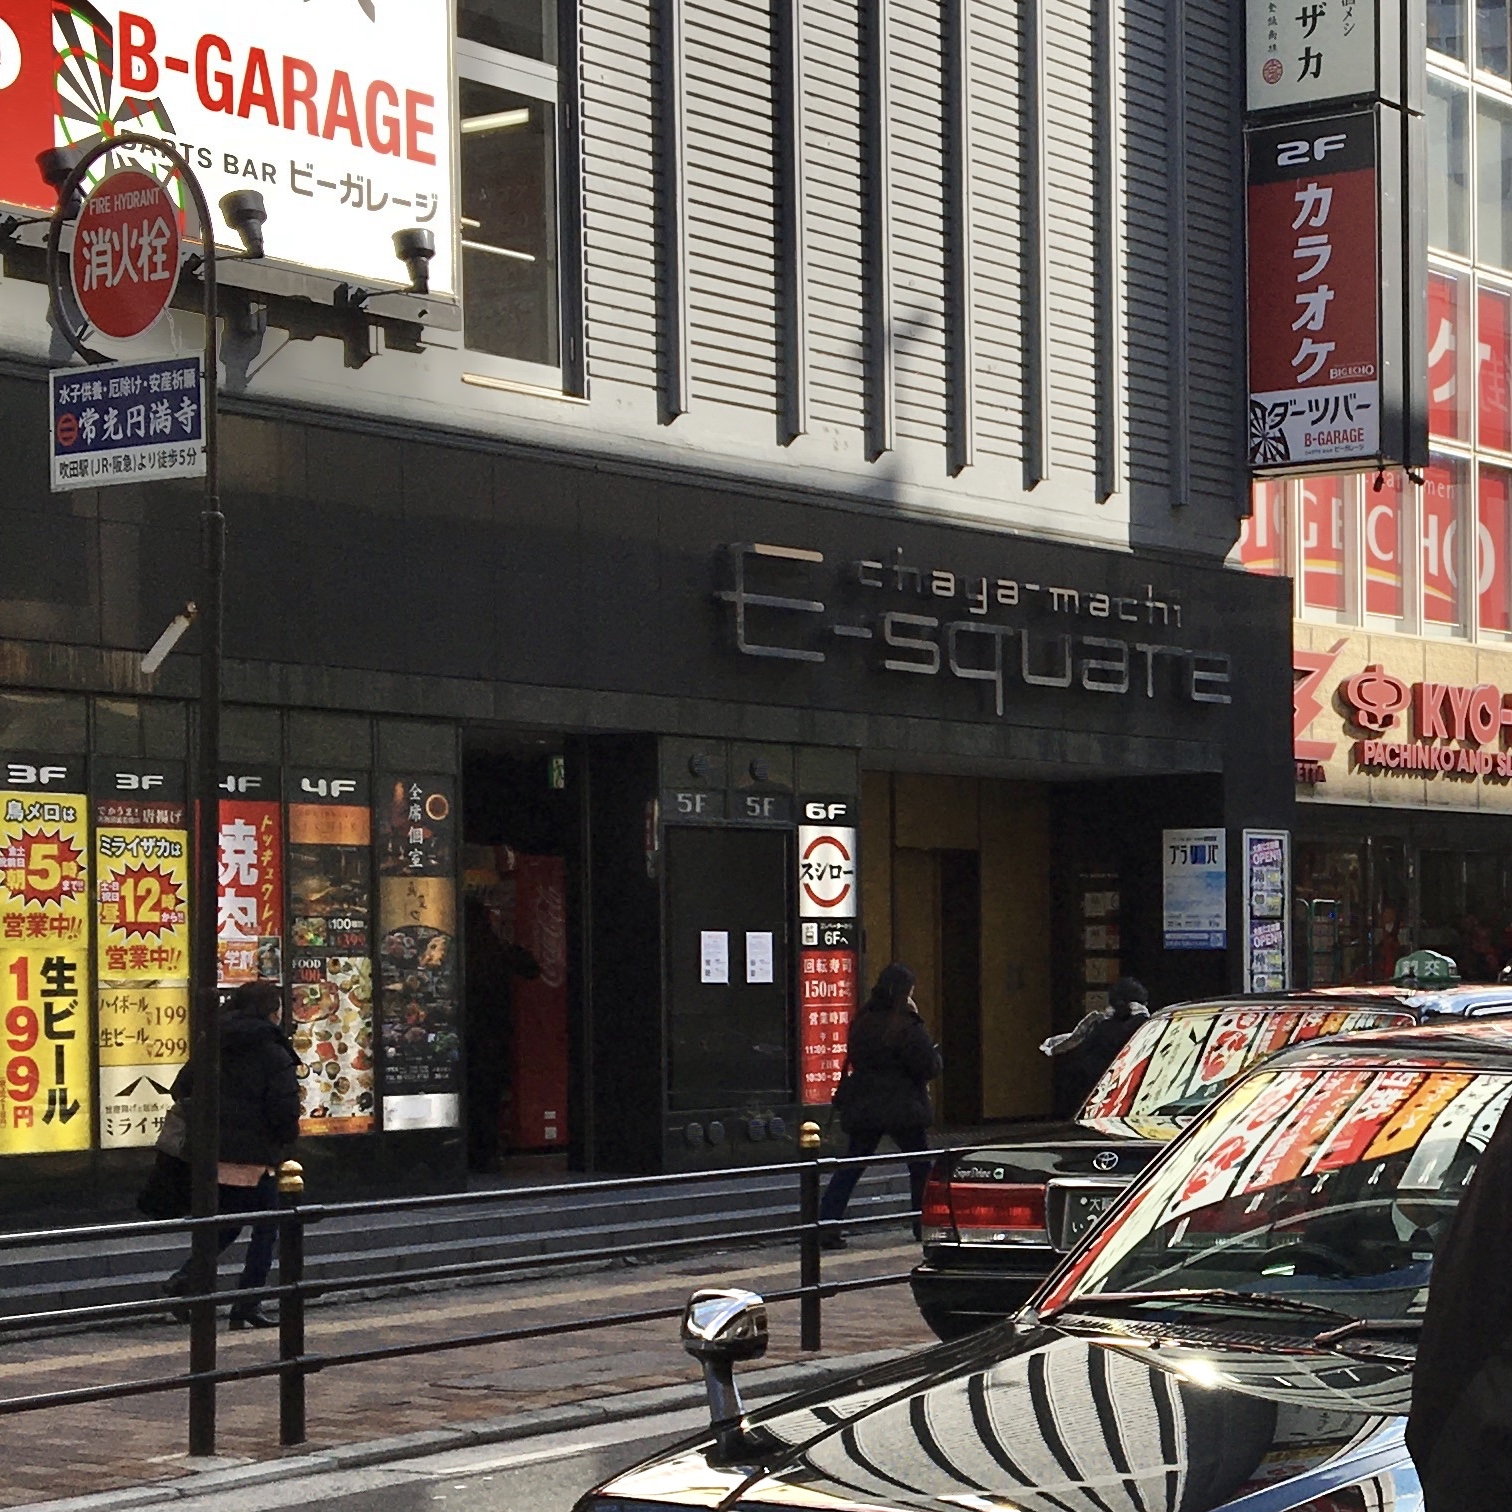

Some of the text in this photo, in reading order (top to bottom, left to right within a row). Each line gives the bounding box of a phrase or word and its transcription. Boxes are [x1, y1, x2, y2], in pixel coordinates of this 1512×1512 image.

[1295, 1, 1327, 82] ザカ
[118, 10, 438, 166] B-GARAGE
[1276, 133, 1347, 167] 2F
[223, 153, 277, 184] BAR
[88, 187, 161, 216] FIRE HYDRANT
[290, 158, 438, 222] ビーガレージ
[82, 217, 171, 292] 消火栓
[1291, 181, 1336, 384] カラオケ
[78, 396, 198, 445] 常光円満寺
[1267, 393, 1372, 430] ダーツバー
[1304, 427, 1365, 448] B-GARAGE
[1362, 740, 1455, 772] PACHINKO
[1456, 749, 1493, 776] AND
[7, 763, 67, 785] 3F
[115, 772, 164, 790] 3F
[301, 777, 357, 797] 4F
[5, 800, 77, 823] 鳥メロは
[677, 793, 708, 814] 5F
[745, 796, 774, 817] 5F
[805, 803, 847, 820] 6F
[408, 783, 424, 869] 全席個室
[99, 834, 183, 858] ミライザカは
[801, 861, 854, 881] スシロー
[2, 912, 83, 940] 営業中!!
[824, 931, 849, 946] 6Fへ
[105, 945, 182, 971] 営業中!!
[100, 995, 149, 1014] ハイボール
[5, 956, 40, 1128] 199円
[40, 956, 82, 1125] 生ビール
[100, 1027, 150, 1048] 生ビール
